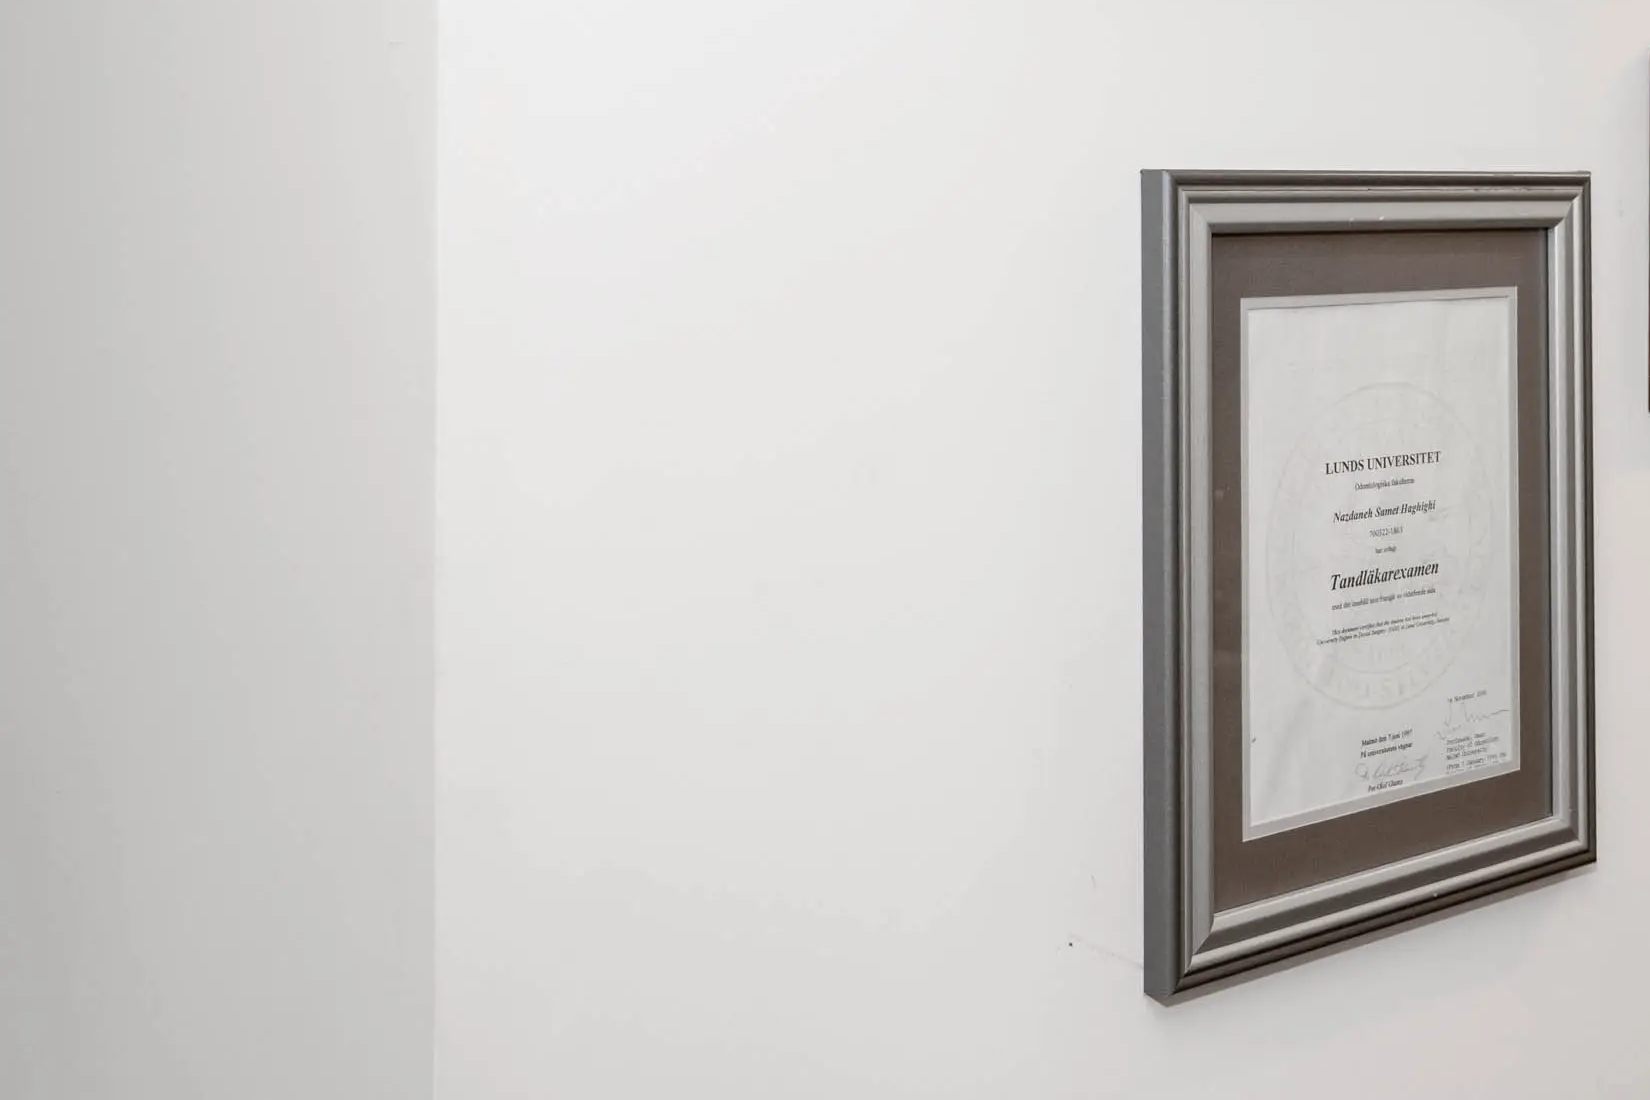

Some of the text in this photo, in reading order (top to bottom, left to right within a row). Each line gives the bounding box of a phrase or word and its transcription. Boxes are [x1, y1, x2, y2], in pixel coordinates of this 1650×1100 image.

[1325, 451, 1441, 475] LUNDS UNIVERSITET
[1333, 500, 1436, 523] Nazdaneh Samet Haghighi
[1330, 562, 1439, 591] Tandläkarexamen
